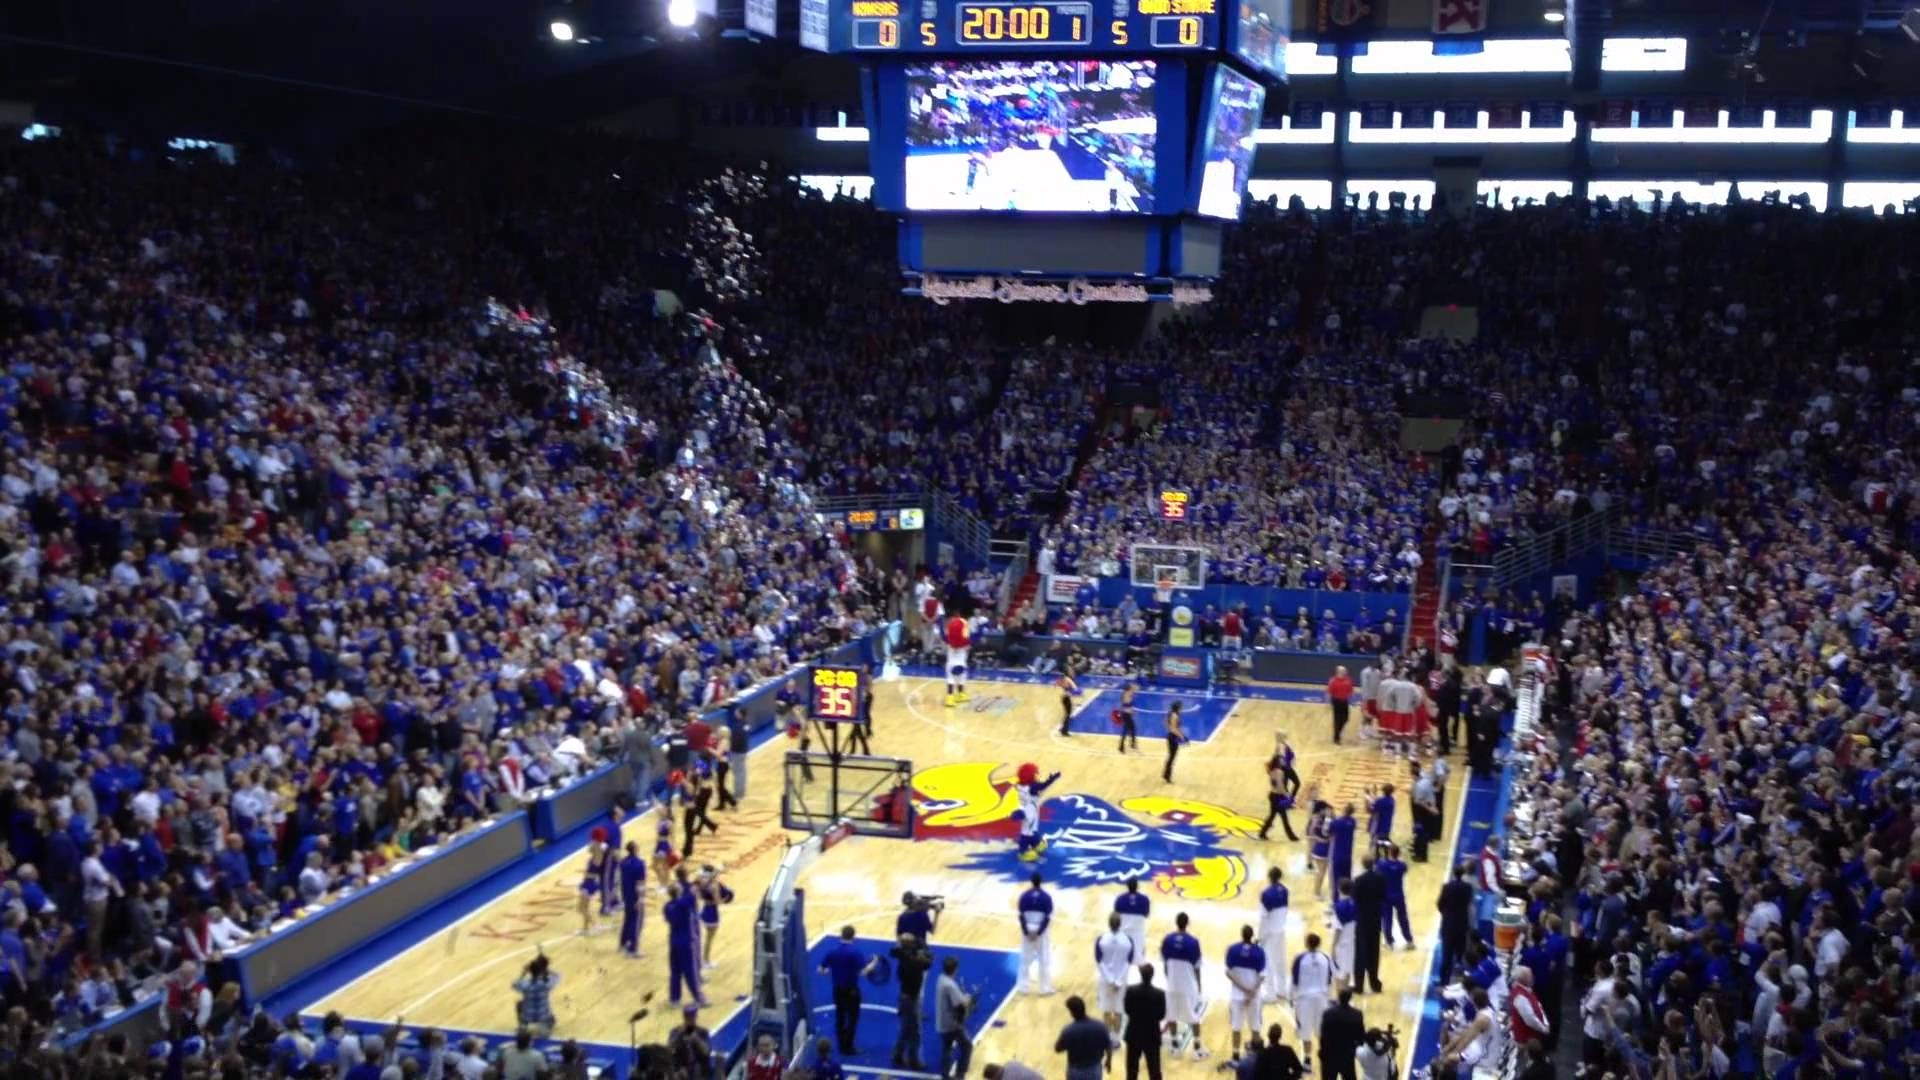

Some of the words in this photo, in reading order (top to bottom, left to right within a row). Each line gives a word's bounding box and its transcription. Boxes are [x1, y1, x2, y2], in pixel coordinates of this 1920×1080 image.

[879, 20, 897, 47] 0
[920, 22, 936, 46] 5
[963, 8, 1050, 40] 20:00
[1072, 16, 1081, 41] 1
[1111, 21, 1128, 45] 5
[1179, 18, 1198, 45] 0
[1164, 502, 1185, 517] 35
[821, 687, 852, 716] 35
